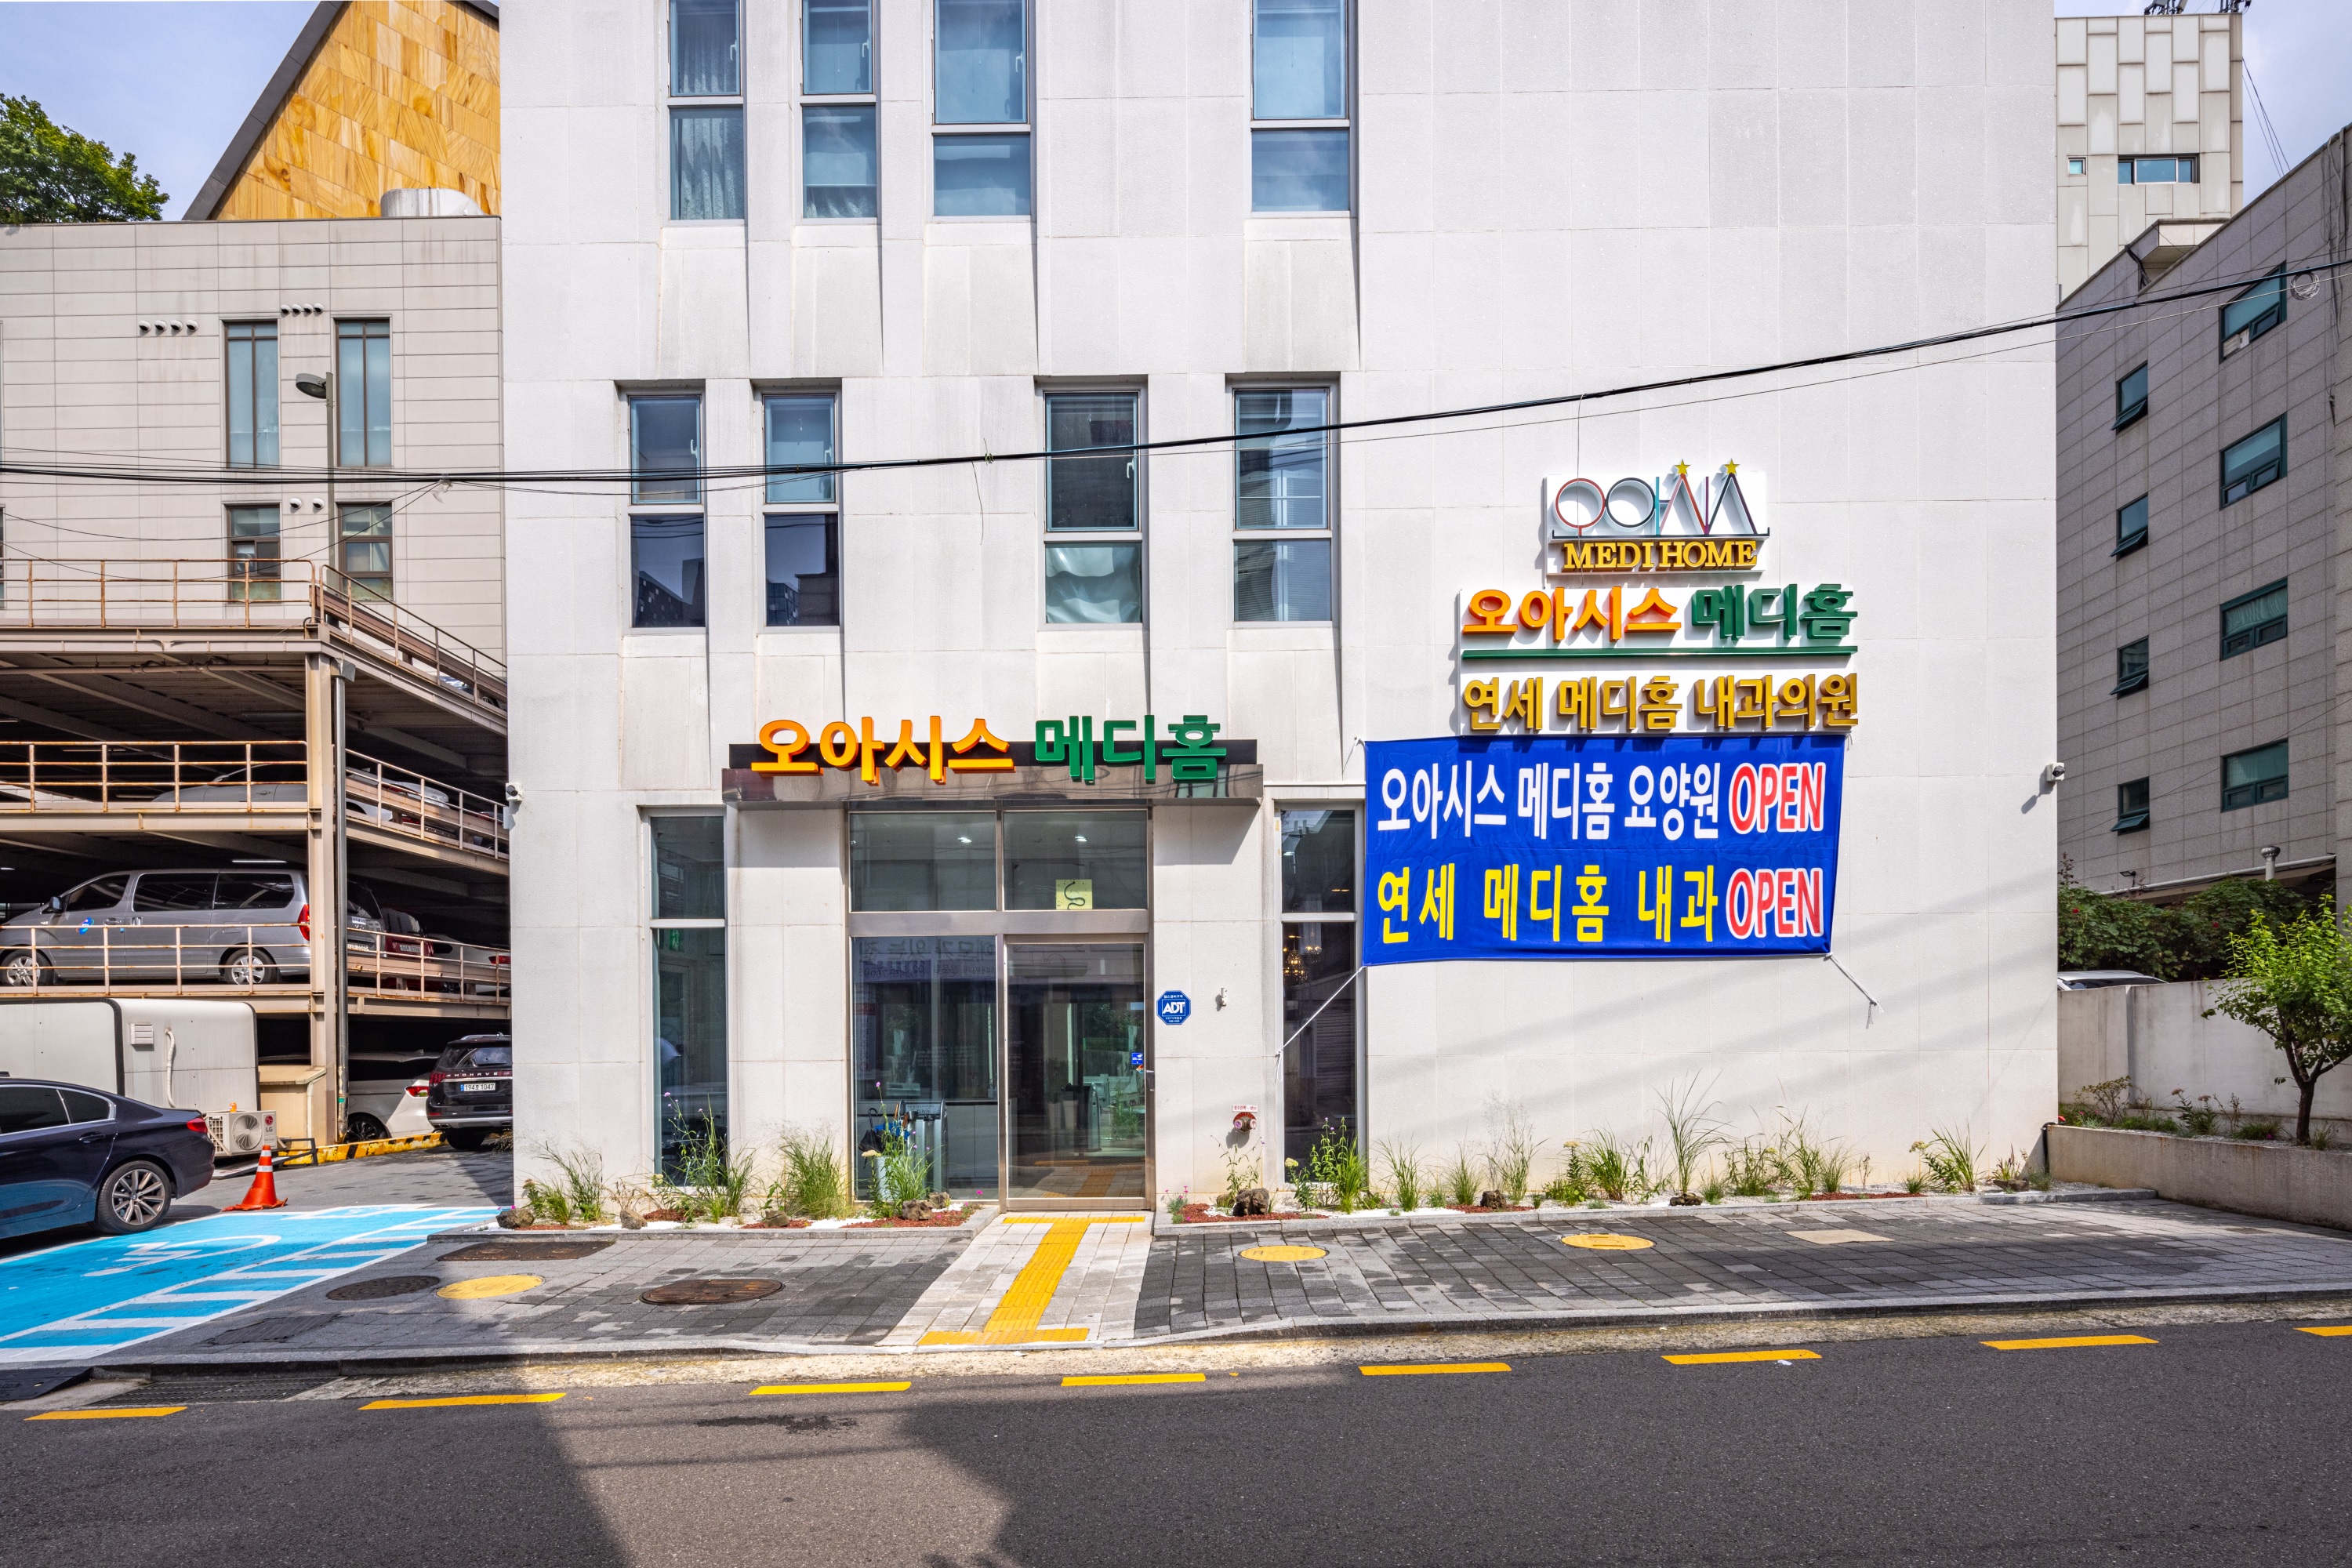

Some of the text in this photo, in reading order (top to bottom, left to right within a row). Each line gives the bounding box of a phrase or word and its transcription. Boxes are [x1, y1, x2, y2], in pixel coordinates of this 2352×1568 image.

[1563, 540, 1758, 572] MEDI HOME
[1462, 583, 1859, 643] 오아시스 메디홈
[1462, 673, 1859, 731] 연세 메디홈 내과의원
[750, 714, 1227, 786] 오아시스 메디홈
[1377, 760, 1827, 840] 오아시스 메디홈 요양원 OPEN
[1377, 862, 1824, 944] 연세 메디홈 내과 OPEN
[1162, 1001, 1185, 1014] ADT
